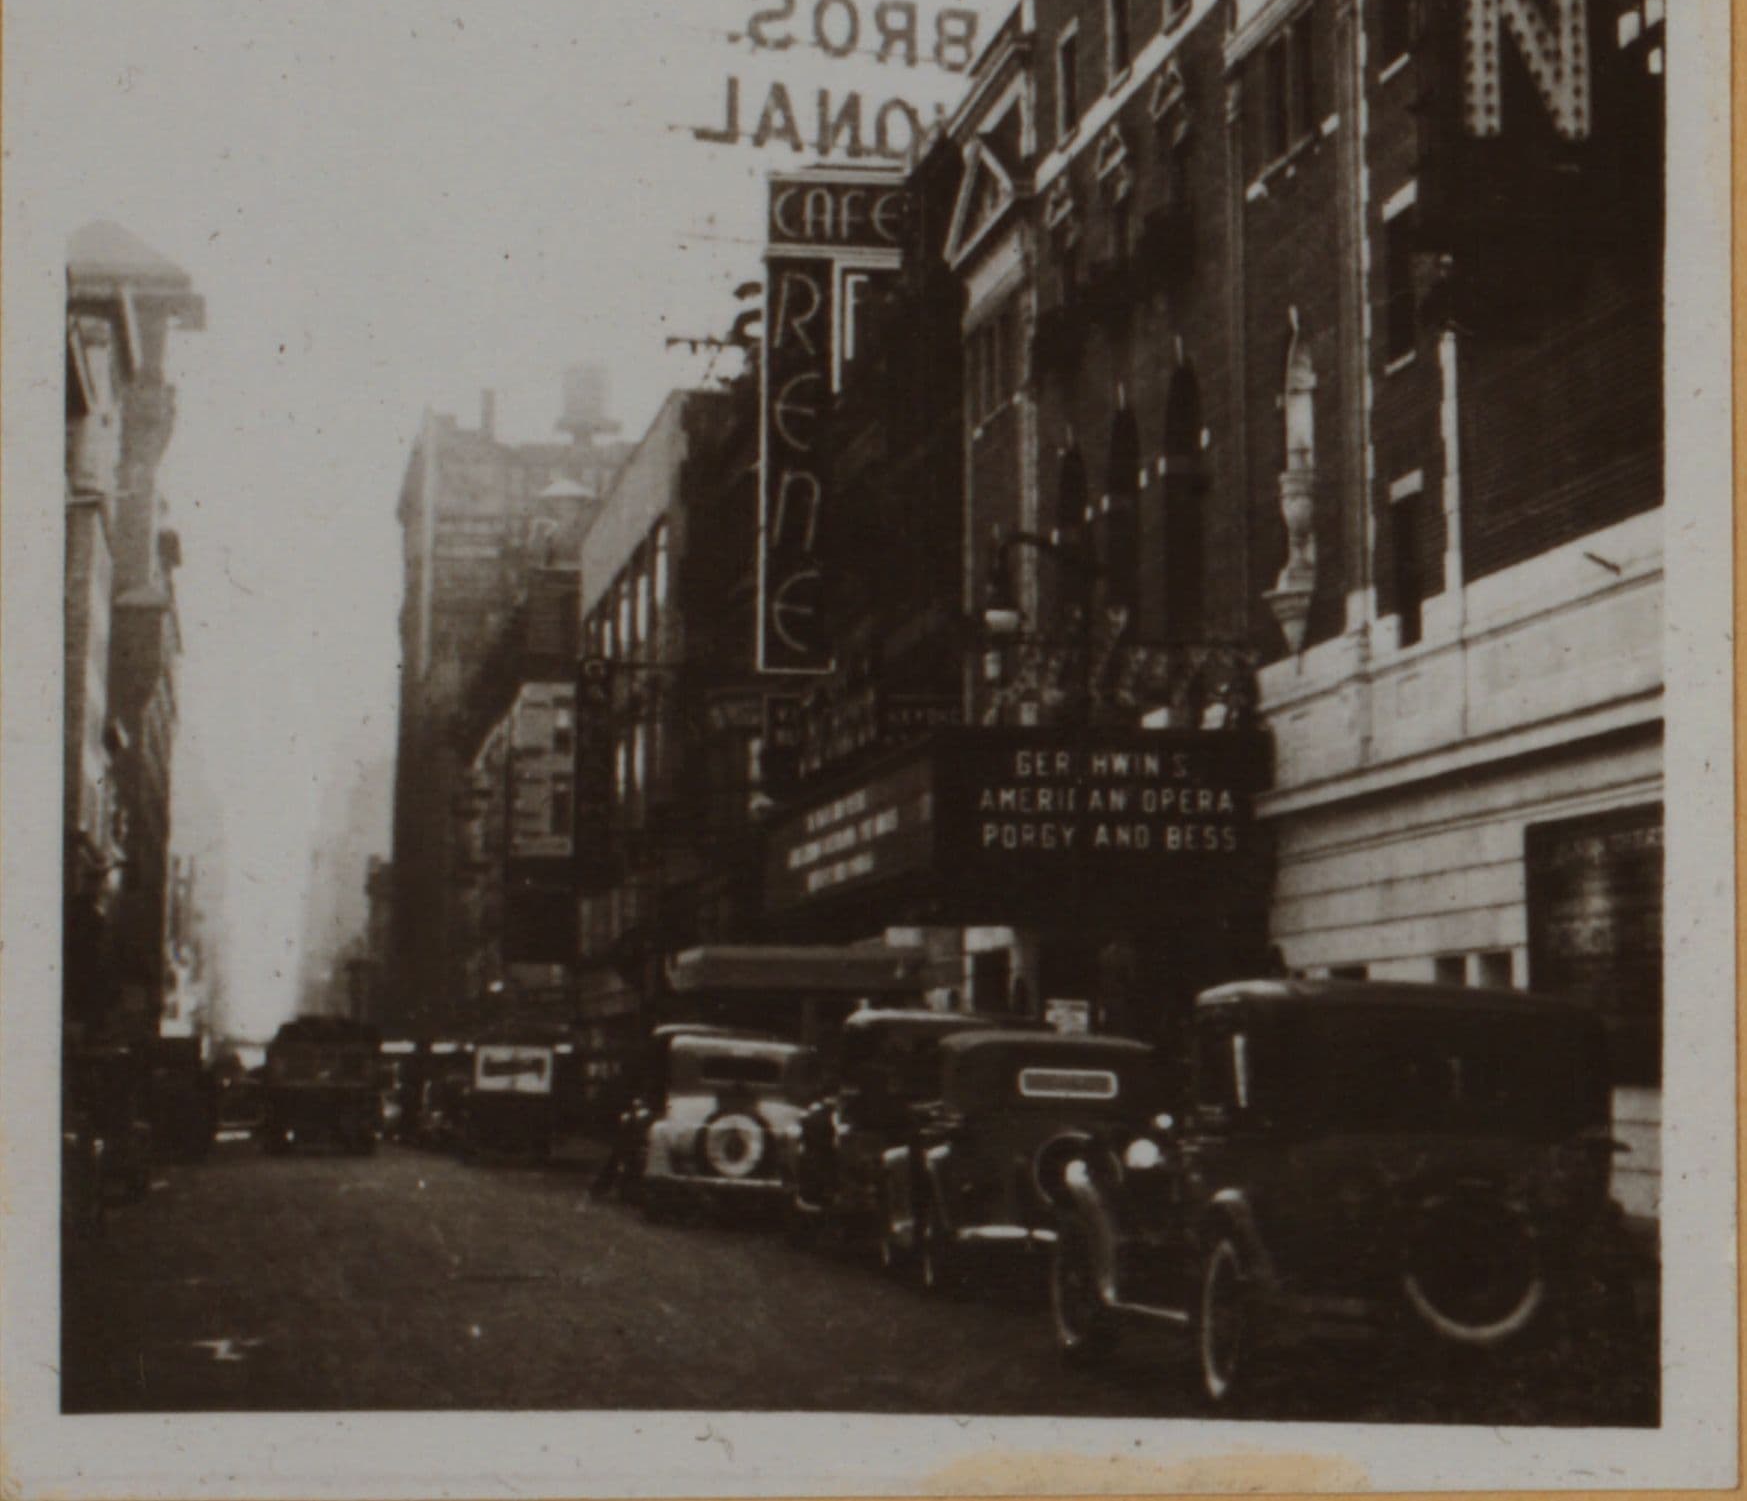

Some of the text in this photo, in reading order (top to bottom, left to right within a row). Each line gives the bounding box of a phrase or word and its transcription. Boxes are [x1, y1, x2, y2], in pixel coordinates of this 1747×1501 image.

[774, 186, 901, 243] CAFE
[1141, 788, 1235, 814] OPERA
[982, 822, 1238, 852] PORGY AND BESS
